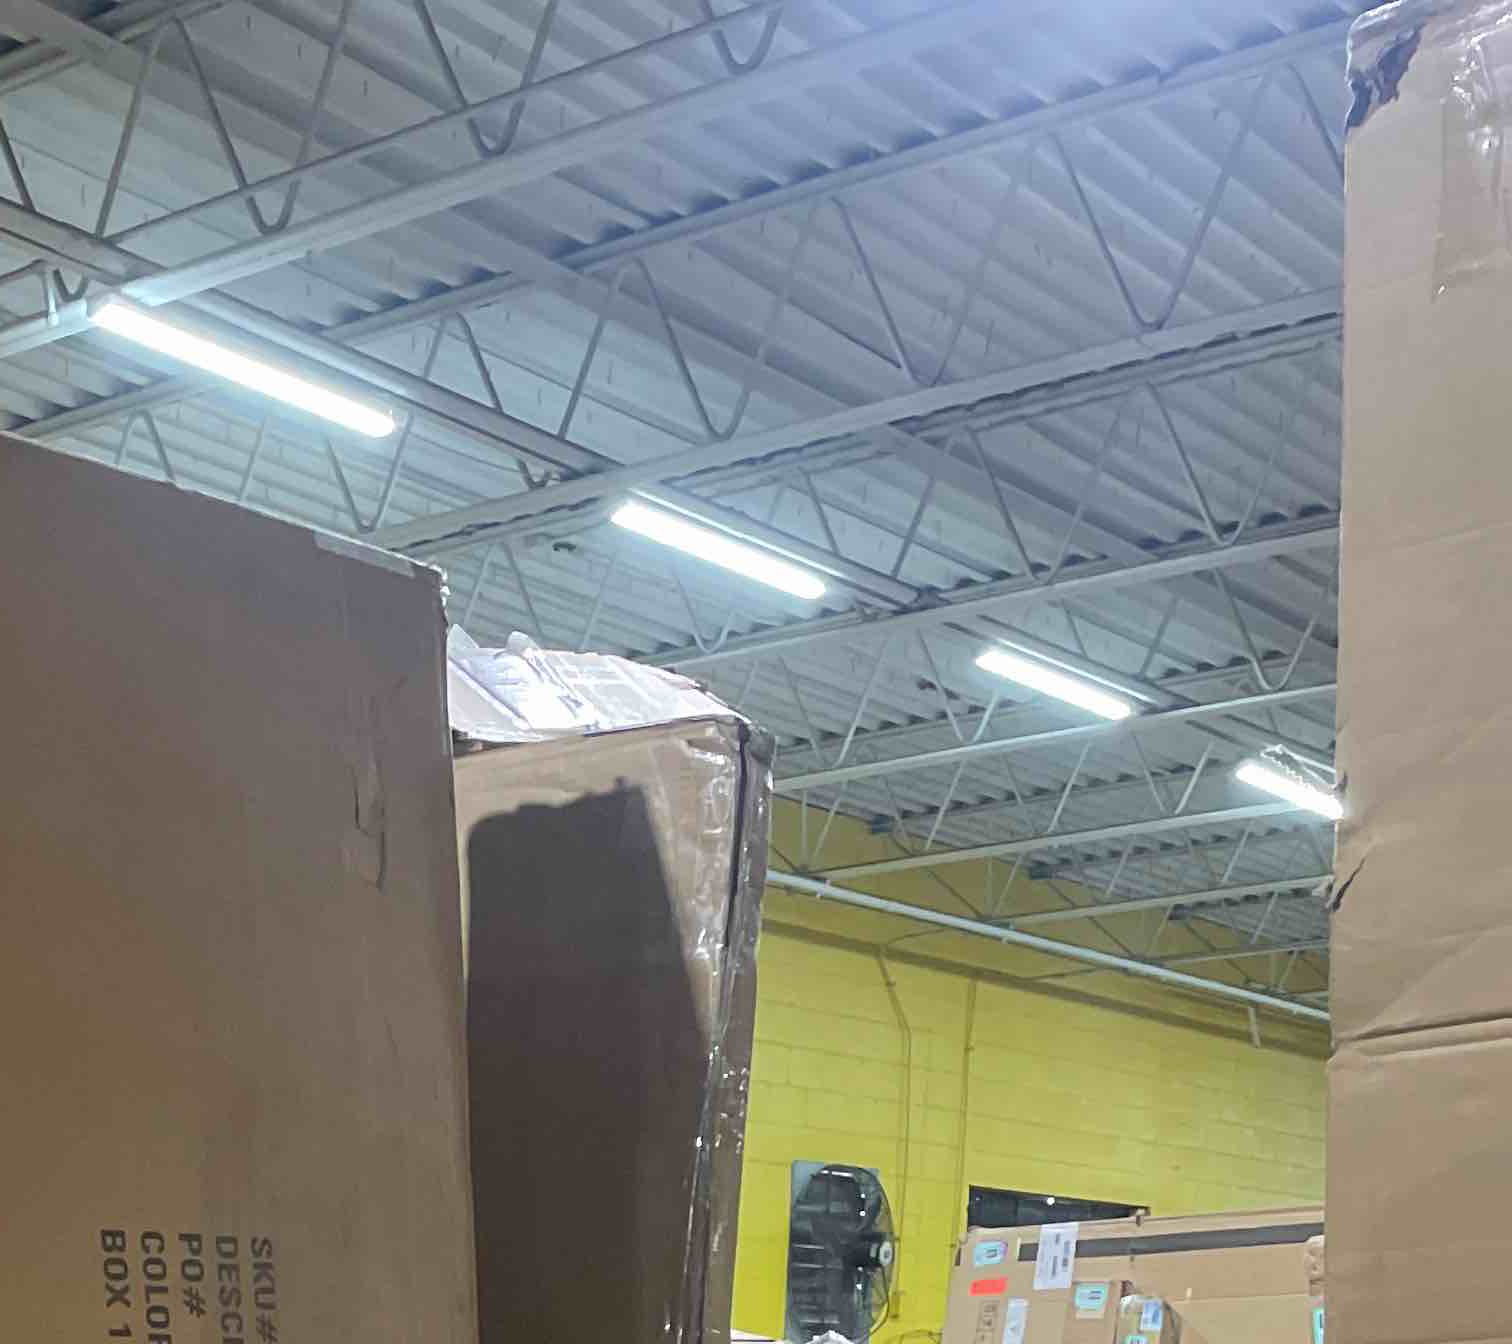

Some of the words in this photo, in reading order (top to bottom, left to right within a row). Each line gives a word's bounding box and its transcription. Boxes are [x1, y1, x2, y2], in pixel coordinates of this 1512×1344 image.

[101, 1229, 131, 1308] BOX
[179, 1232, 207, 1319] PO#
[251, 1236, 278, 1344] SKU#
[108, 1324, 133, 1338] 1
